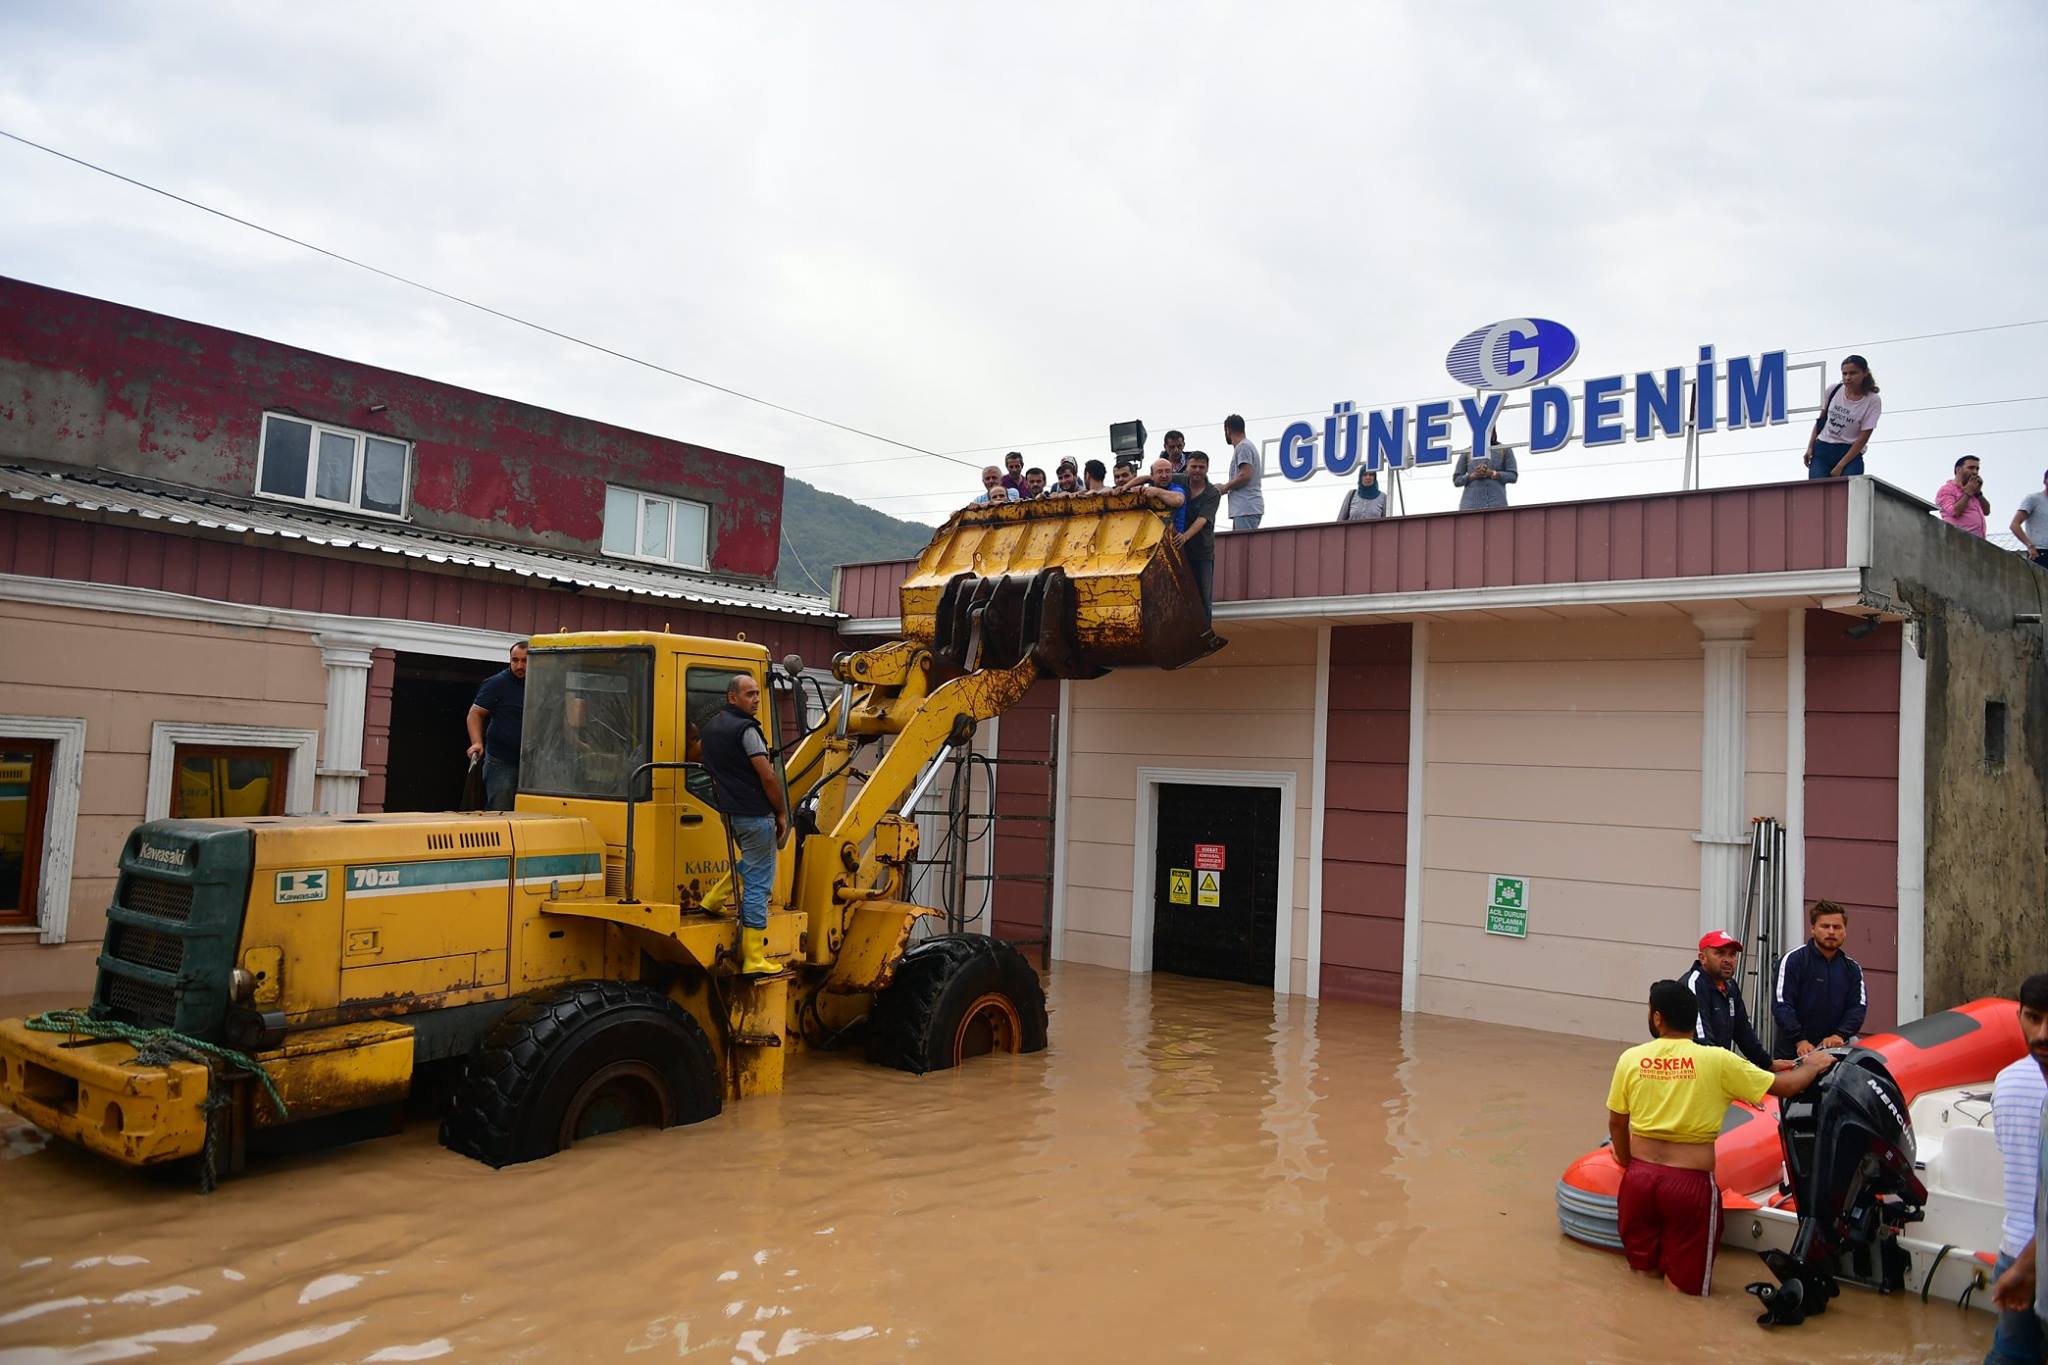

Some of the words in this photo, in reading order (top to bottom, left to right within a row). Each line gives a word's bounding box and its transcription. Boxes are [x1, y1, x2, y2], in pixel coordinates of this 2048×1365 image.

[1279, 393, 1507, 482] GÜNEY
[1529, 344, 1789, 454] DENİM
[139, 842, 186, 866] Kawasaki
[685, 860, 730, 874] KARAD
[279, 891, 323, 902] Kawasaki
[1490, 916, 1523, 926] TOPLANMA
[1504, 910, 1525, 919] DURUM
[1640, 1057, 1694, 1070] OSKEM
[1867, 1079, 1915, 1151] MERCURY
